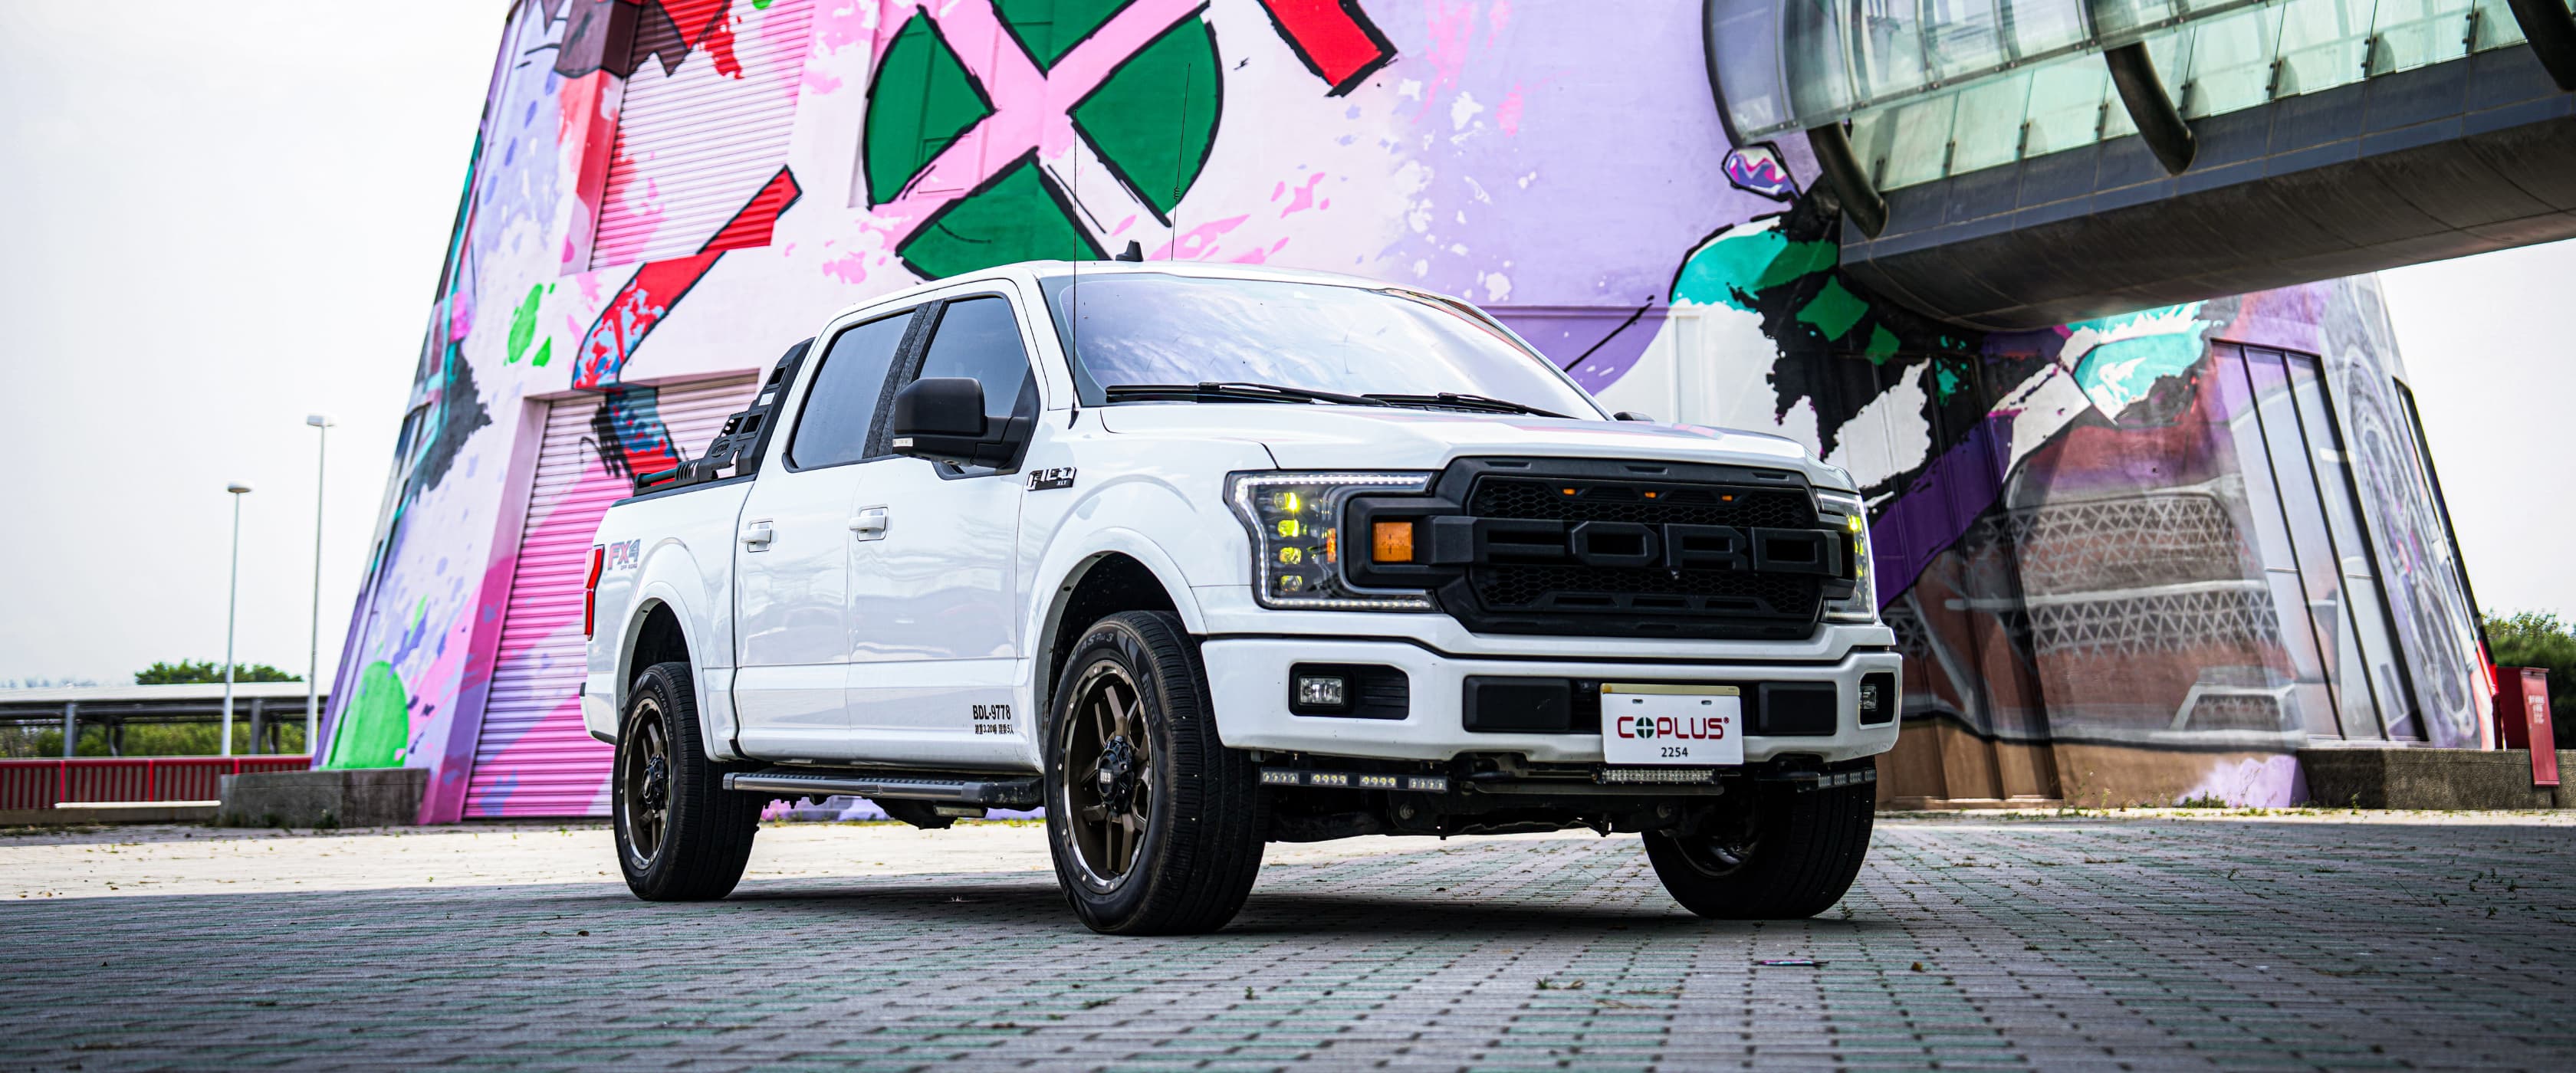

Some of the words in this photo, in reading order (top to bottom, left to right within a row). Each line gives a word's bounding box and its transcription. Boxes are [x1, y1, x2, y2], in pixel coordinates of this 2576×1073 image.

[607, 539, 641, 571] FX4
[1473, 517, 1841, 577] FORD
[972, 704, 1011, 720] BDL-9778
[1661, 747, 1689, 758] 2254
